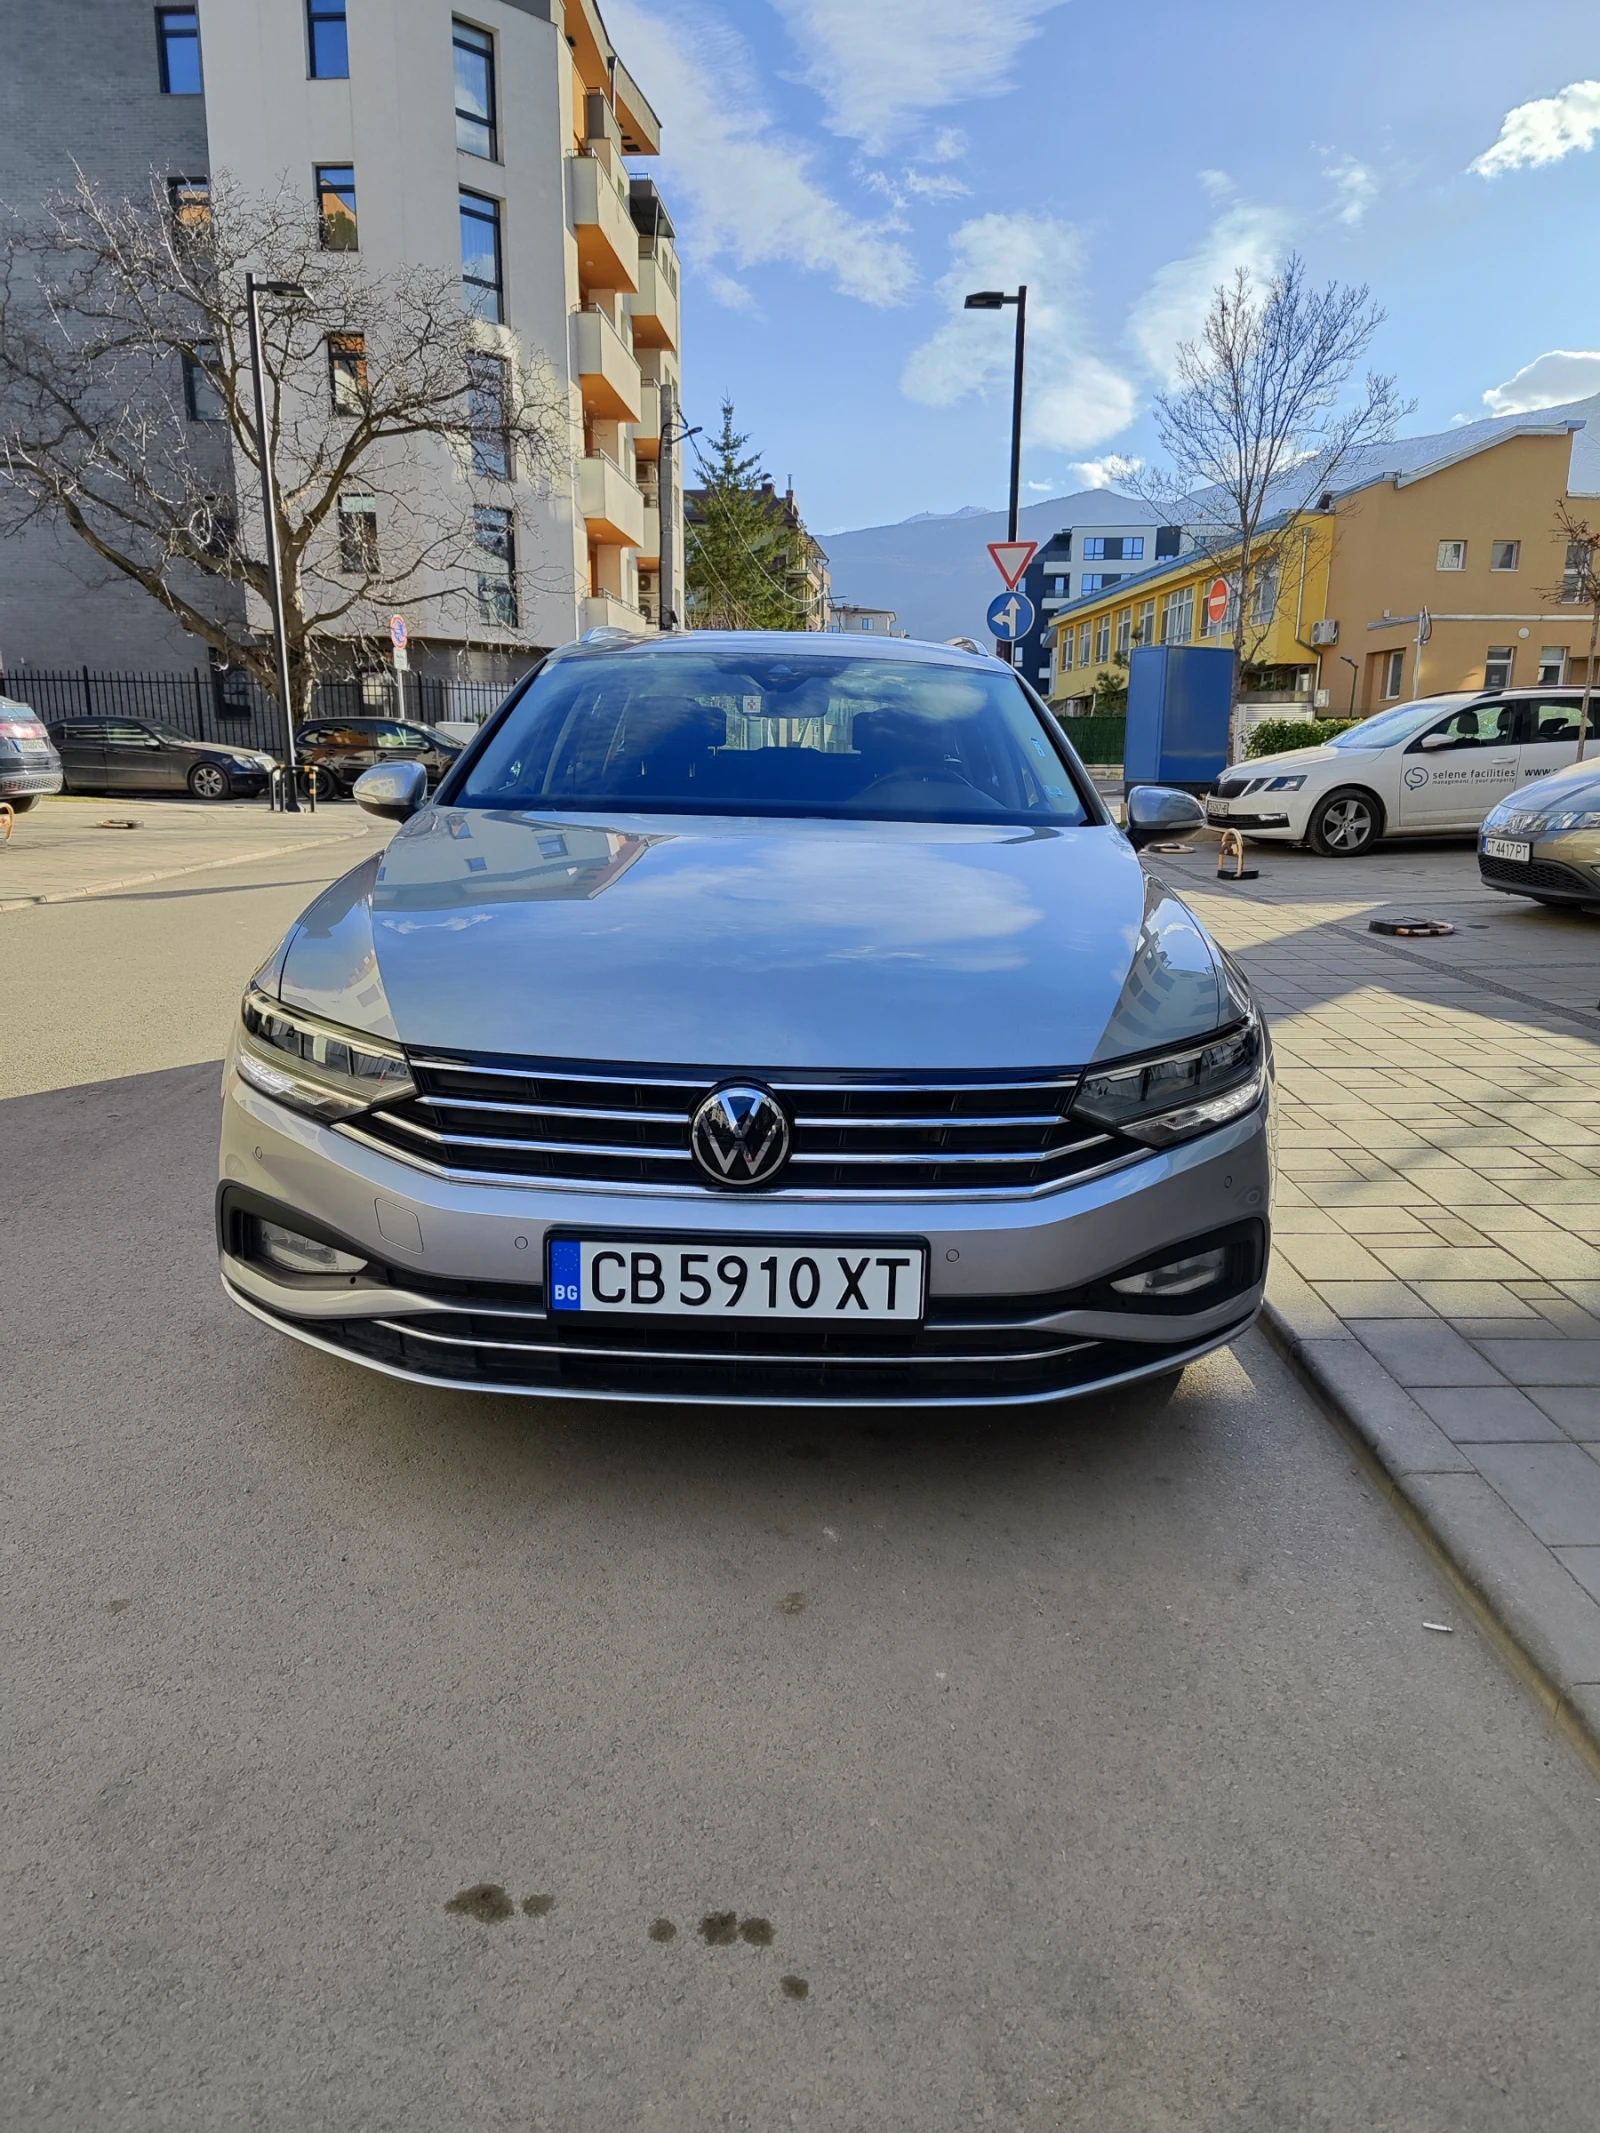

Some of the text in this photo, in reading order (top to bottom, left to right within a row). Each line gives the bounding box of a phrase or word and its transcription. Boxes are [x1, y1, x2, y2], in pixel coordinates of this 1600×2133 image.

[1433, 769, 1516, 780] selene facilities
[1487, 840, 1528, 859] CT 4417 PT
[591, 1251, 911, 1310] CB 5910 XT
[554, 1284, 578, 1301] BG
